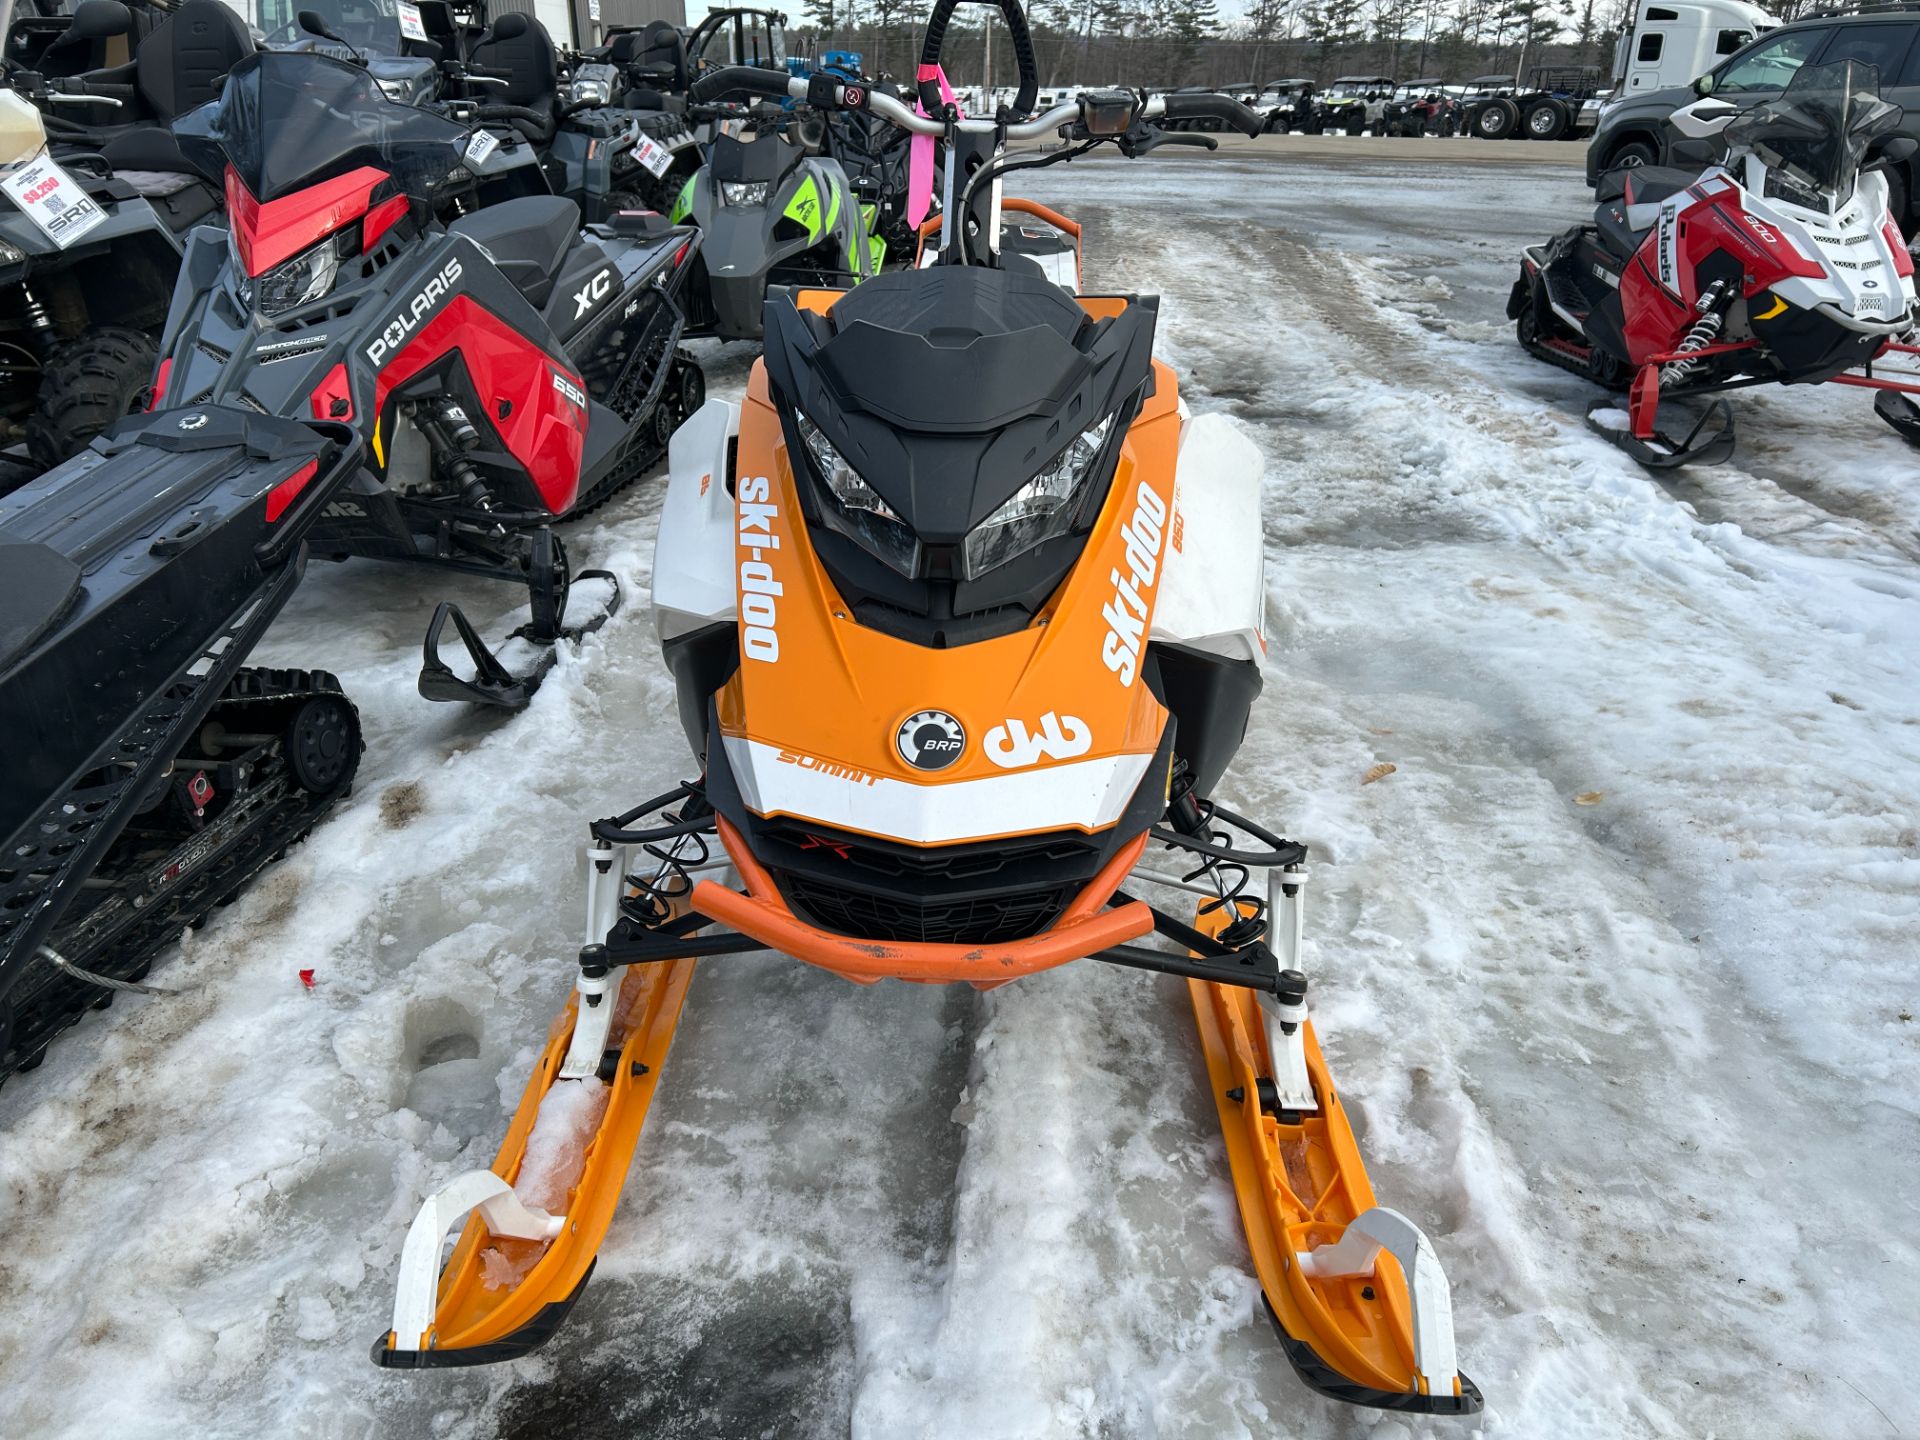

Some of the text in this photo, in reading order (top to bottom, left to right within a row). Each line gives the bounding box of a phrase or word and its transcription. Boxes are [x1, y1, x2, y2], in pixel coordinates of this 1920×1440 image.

[1661, 204, 1676, 283] Polaris
[1743, 215, 1777, 243] 800
[366, 256, 463, 367] POLARIS
[573, 268, 610, 320] XC
[553, 374, 585, 408] 650
[1172, 511, 1185, 554] 850
[739, 476, 784, 663] ski-doo
[1101, 481, 1167, 688] ski-doo
[776, 750, 884, 787] SUMMIT
[923, 739, 961, 752] BRP
